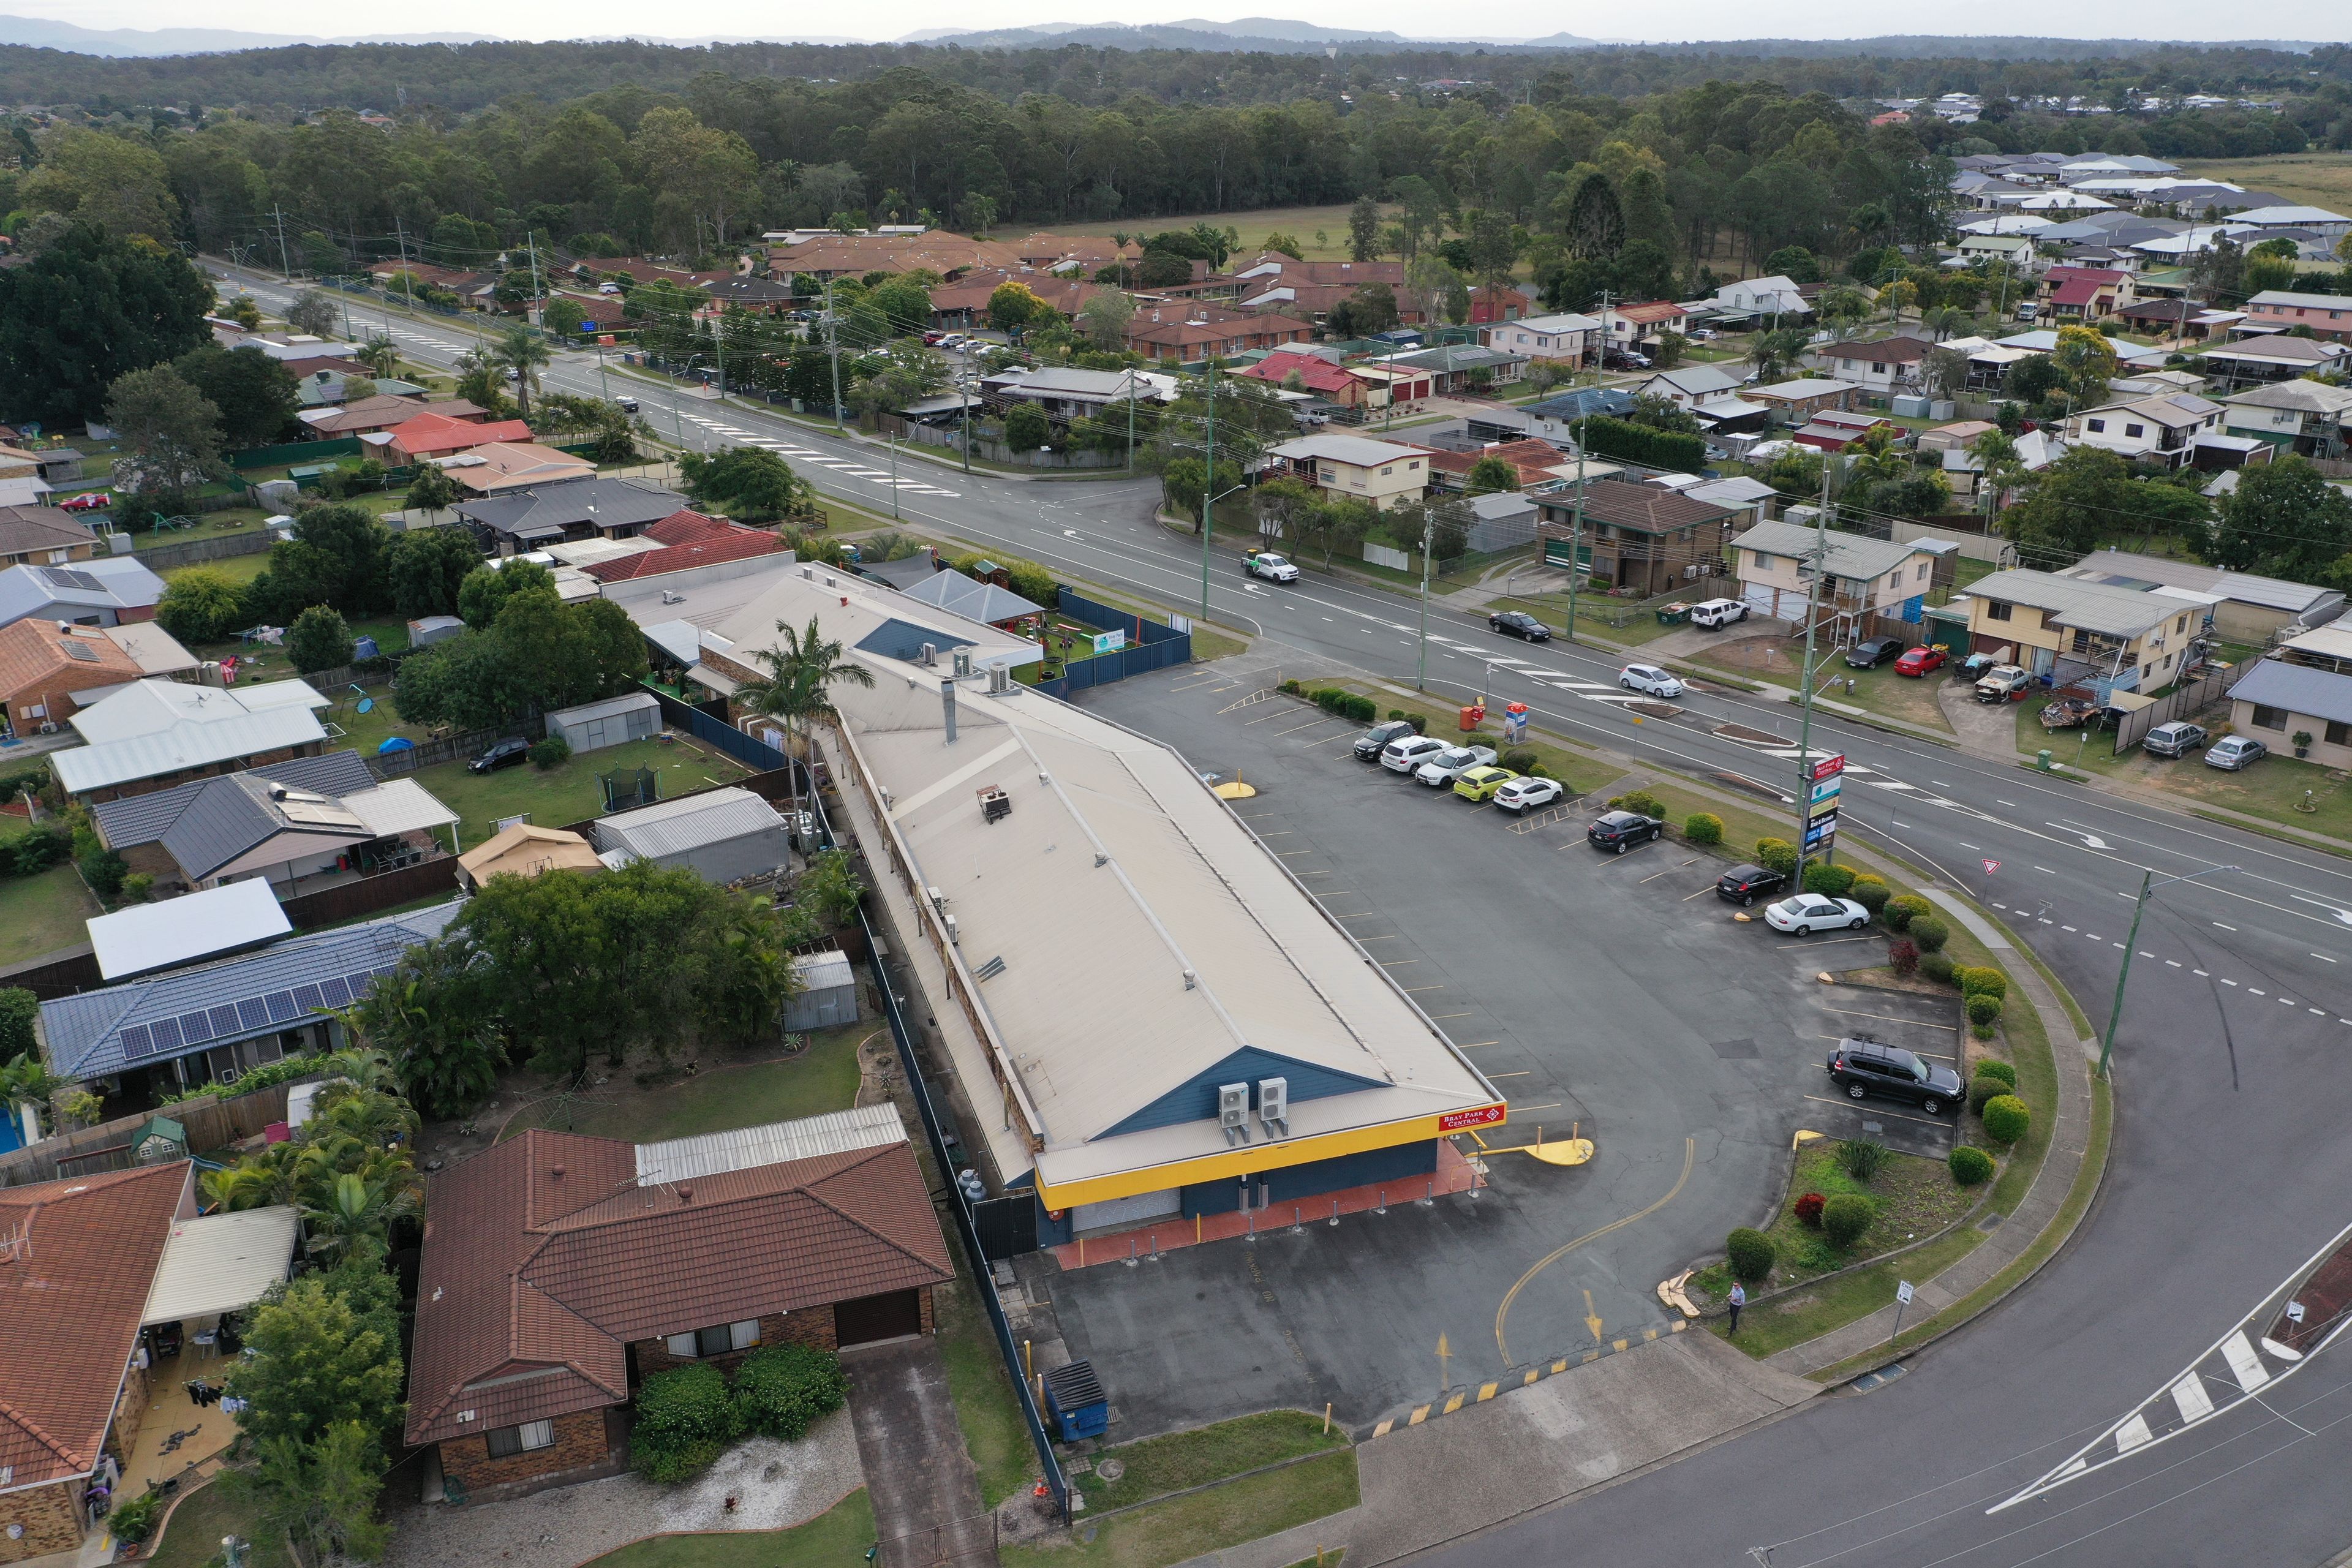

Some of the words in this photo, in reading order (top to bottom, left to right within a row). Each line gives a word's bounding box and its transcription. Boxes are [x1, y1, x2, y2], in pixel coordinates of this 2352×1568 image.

[1817, 766, 1832, 775] CENTRAL
[1448, 1118, 1480, 1127] CENTRAL
[1262, 1290, 1275, 1302] NO
